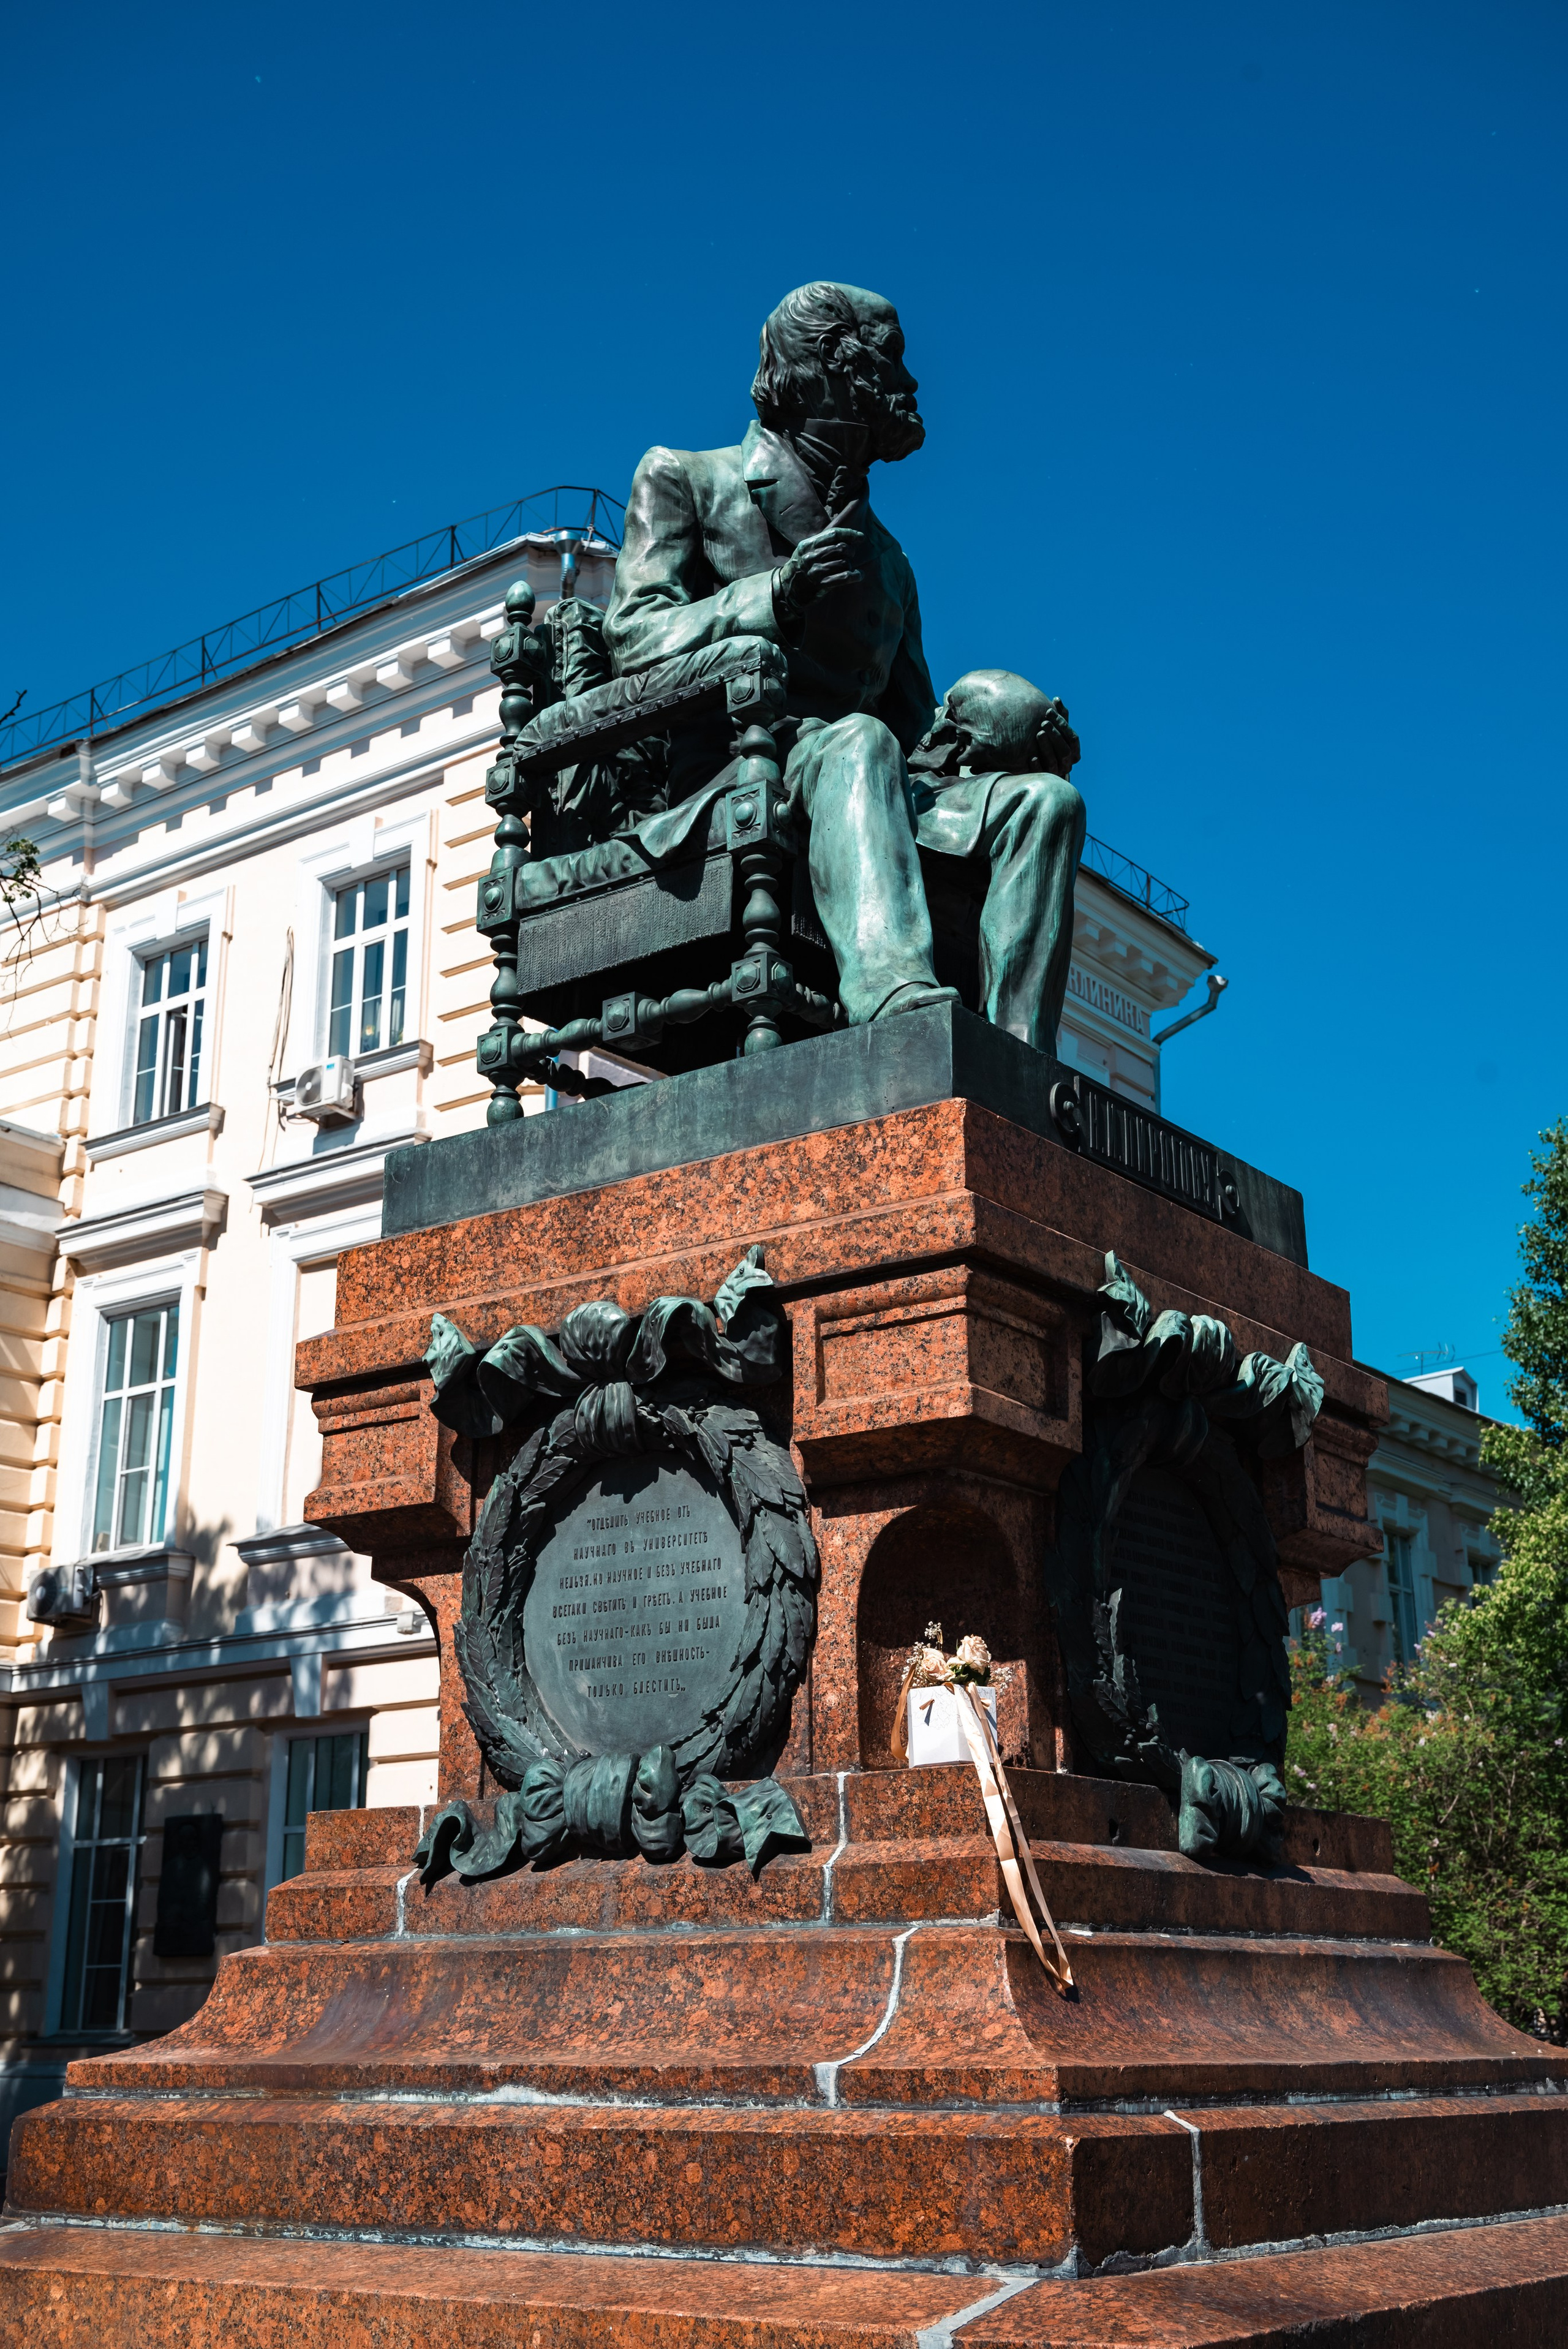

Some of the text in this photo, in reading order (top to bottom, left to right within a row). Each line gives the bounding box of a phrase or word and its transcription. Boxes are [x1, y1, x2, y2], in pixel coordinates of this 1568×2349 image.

[636, 1507, 671, 1525] УЧЕБНОЕ
[677, 1505, 691, 1518] ОТЪ
[573, 1543, 616, 1560] НАУЧНАГО
[624, 1540, 635, 1554] ВЪ
[607, 1567, 643, 1584] НАУЧНОЕ
[647, 1566, 652, 1578] И
[656, 1563, 676, 1578] БЕЗЪ
[680, 1557, 722, 1575] УЧЕБНАГО
[552, 1602, 587, 1619] ВСЕТАКИ
[633, 1596, 637, 1608] И
[679, 1591, 683, 1604] А
[690, 1586, 727, 1602] УЧЕБНОЕ
[557, 1631, 576, 1646] БЕЗЪ
[659, 1621, 671, 1635] БЫ
[678, 1619, 689, 1632] НИ
[696, 1615, 720, 1631] БЫЛА
[569, 1654, 622, 1672] ПРИМАНЧИВА
[633, 1653, 646, 1665] ЕГО
[587, 1683, 624, 1698] ТОЛЬКО
